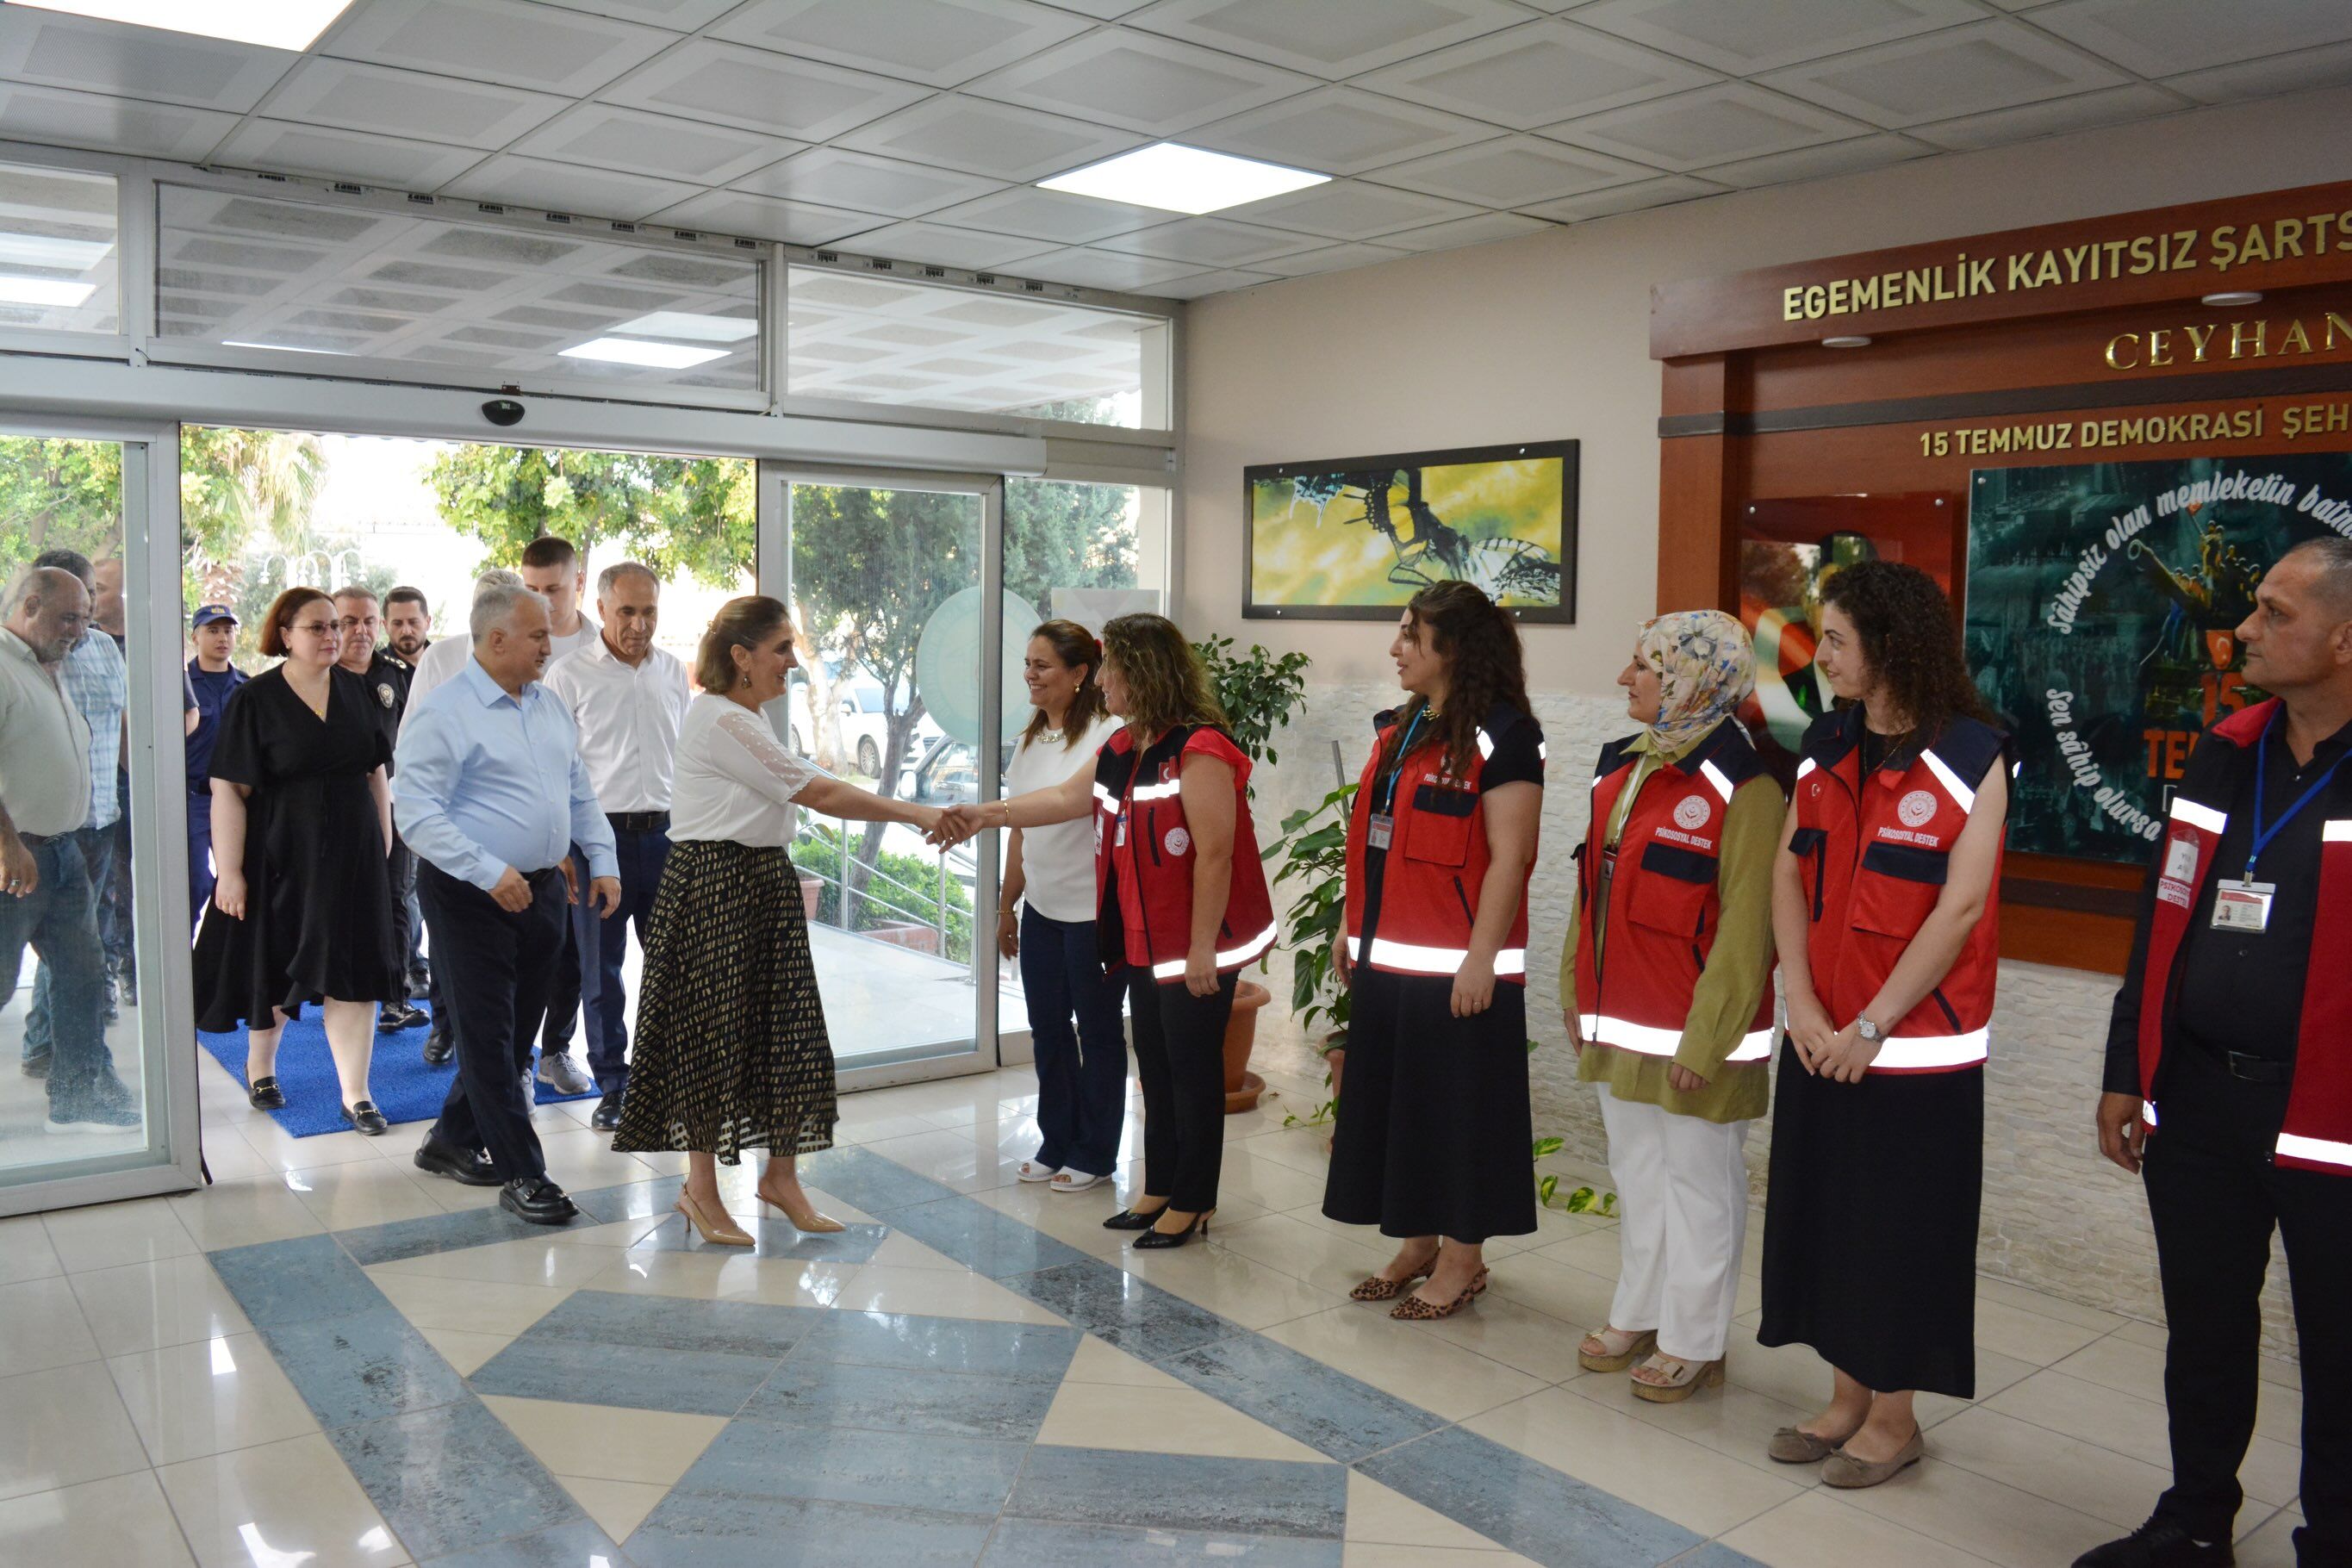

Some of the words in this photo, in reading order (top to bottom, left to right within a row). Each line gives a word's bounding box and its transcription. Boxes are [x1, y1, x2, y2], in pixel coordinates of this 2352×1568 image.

[1783, 252, 1997, 321] EGEMENLİK
[2007, 229, 2198, 291] KAYITSIZ
[2209, 209, 2352, 272] ŞARTS
[2106, 312, 2352, 370] CEYHAN
[1920, 432, 1949, 457] 15
[1955, 422, 2072, 455] TEMMUZ
[2081, 403, 2263, 448] DEMOKRASİ
[2281, 403, 2349, 440] ŞEH
[2105, 504, 2152, 551] olan
[2156, 470, 2296, 517] memleketin
[2297, 484, 2352, 541] batm
[1690, 835, 1713, 849] DESTEK
